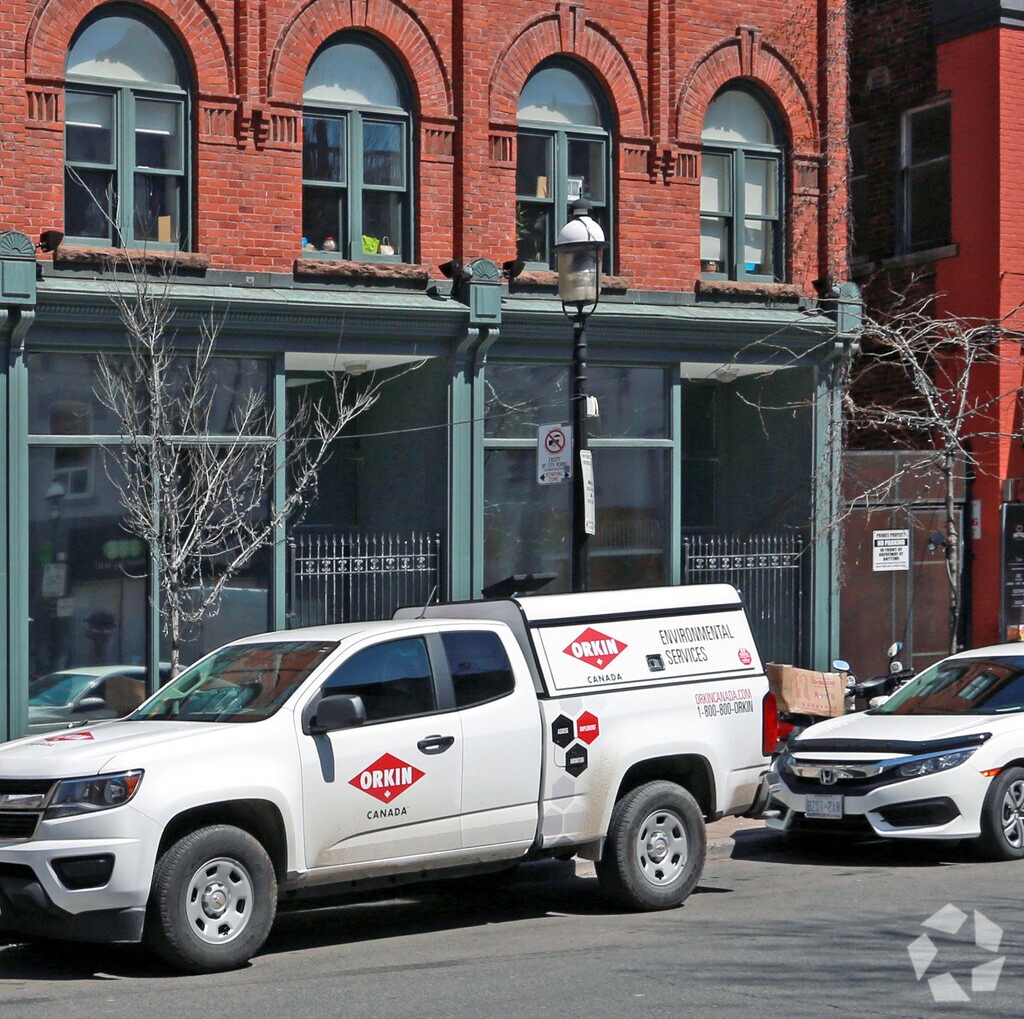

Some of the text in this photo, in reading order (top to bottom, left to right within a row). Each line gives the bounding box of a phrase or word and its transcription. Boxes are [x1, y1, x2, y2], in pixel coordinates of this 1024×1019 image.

[658, 624, 734, 645] ENVIRONMENTAL
[571, 638, 620, 658] ORKIN
[665, 646, 708, 665] SERVICES
[587, 673, 623, 684] CANADA
[695, 688, 752, 705] ORKINCANADA.COM
[697, 700, 754, 718] 1-800-800-ORKIN
[360, 766, 413, 790] ORKIN
[367, 807, 407, 819] CANADA
